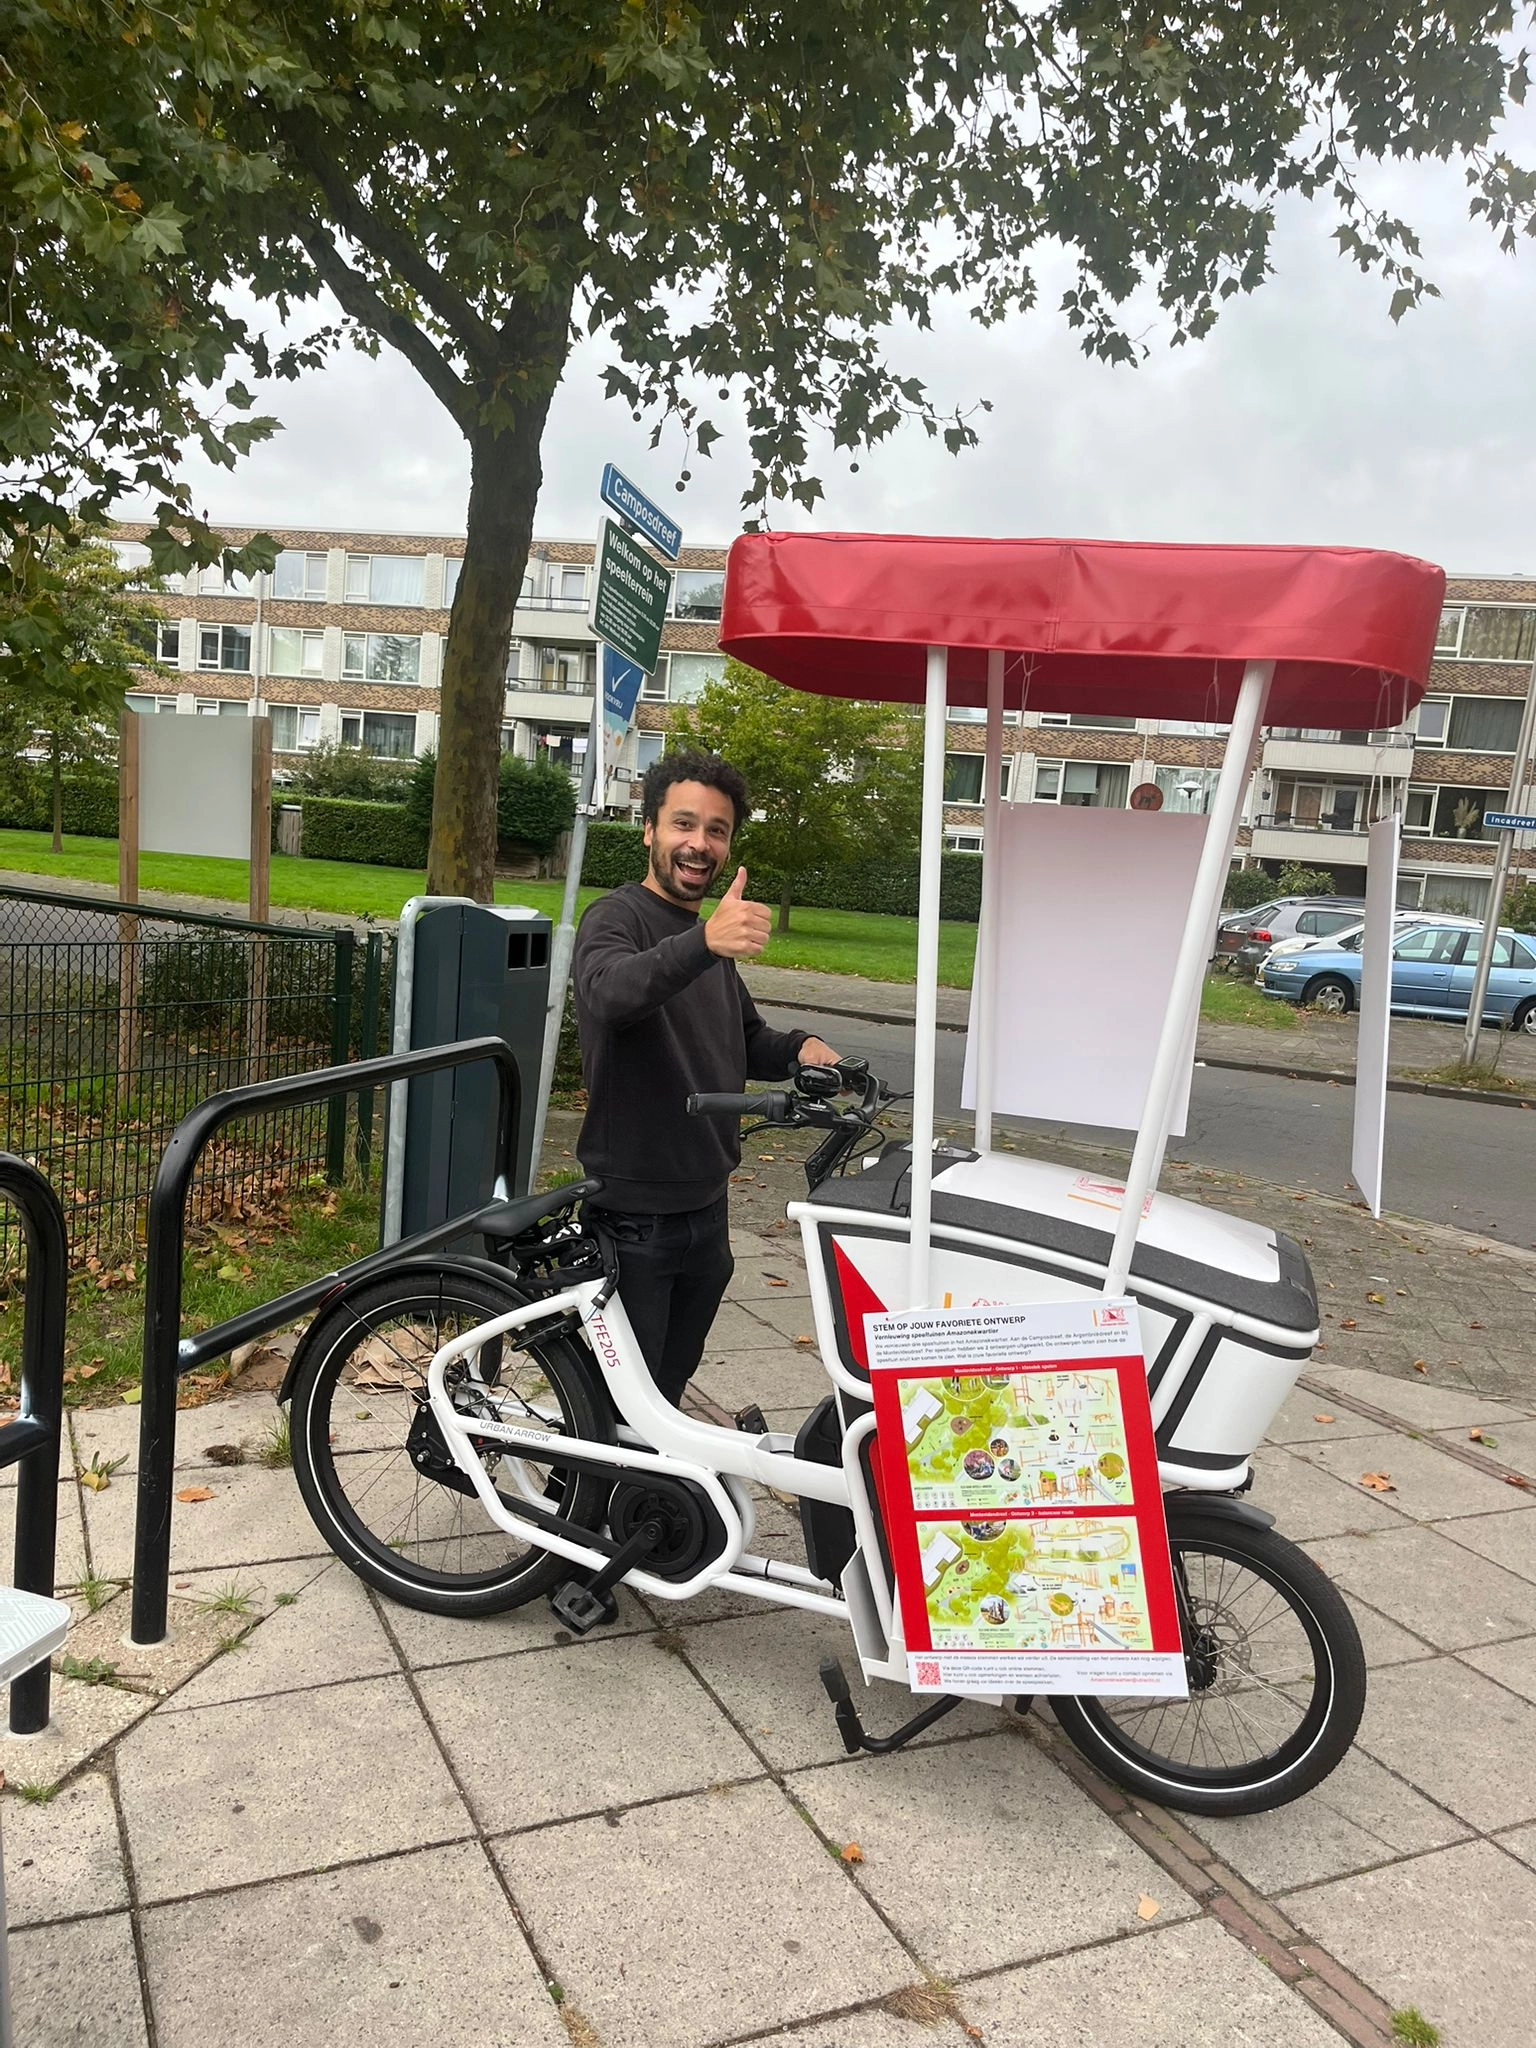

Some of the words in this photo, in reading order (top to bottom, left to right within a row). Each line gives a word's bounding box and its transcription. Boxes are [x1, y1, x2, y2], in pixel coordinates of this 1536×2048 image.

[614, 478, 677, 547] Camposdreef
[608, 530, 642, 571] Welkom
[642, 563, 653, 584] op
[653, 571, 667, 594] het
[605, 557, 654, 607] speelterrein
[1491, 816, 1536, 827] Incadreef
[591, 1314, 621, 1368] TFE205
[873, 1324, 895, 1332] STEM
[896, 1323, 909, 1331] OP
[909, 1321, 934, 1330] JOUW
[935, 1318, 982, 1328] FAVORIETE
[983, 1316, 1026, 1325] ONTWERP
[874, 1333, 911, 1341] Vernieuwing
[911, 1331, 946, 1339] speeltuinen
[946, 1328, 999, 1336] Amazonekwartier
[480, 1421, 514, 1436] URBAN
[514, 1426, 551, 1442] ARROW
